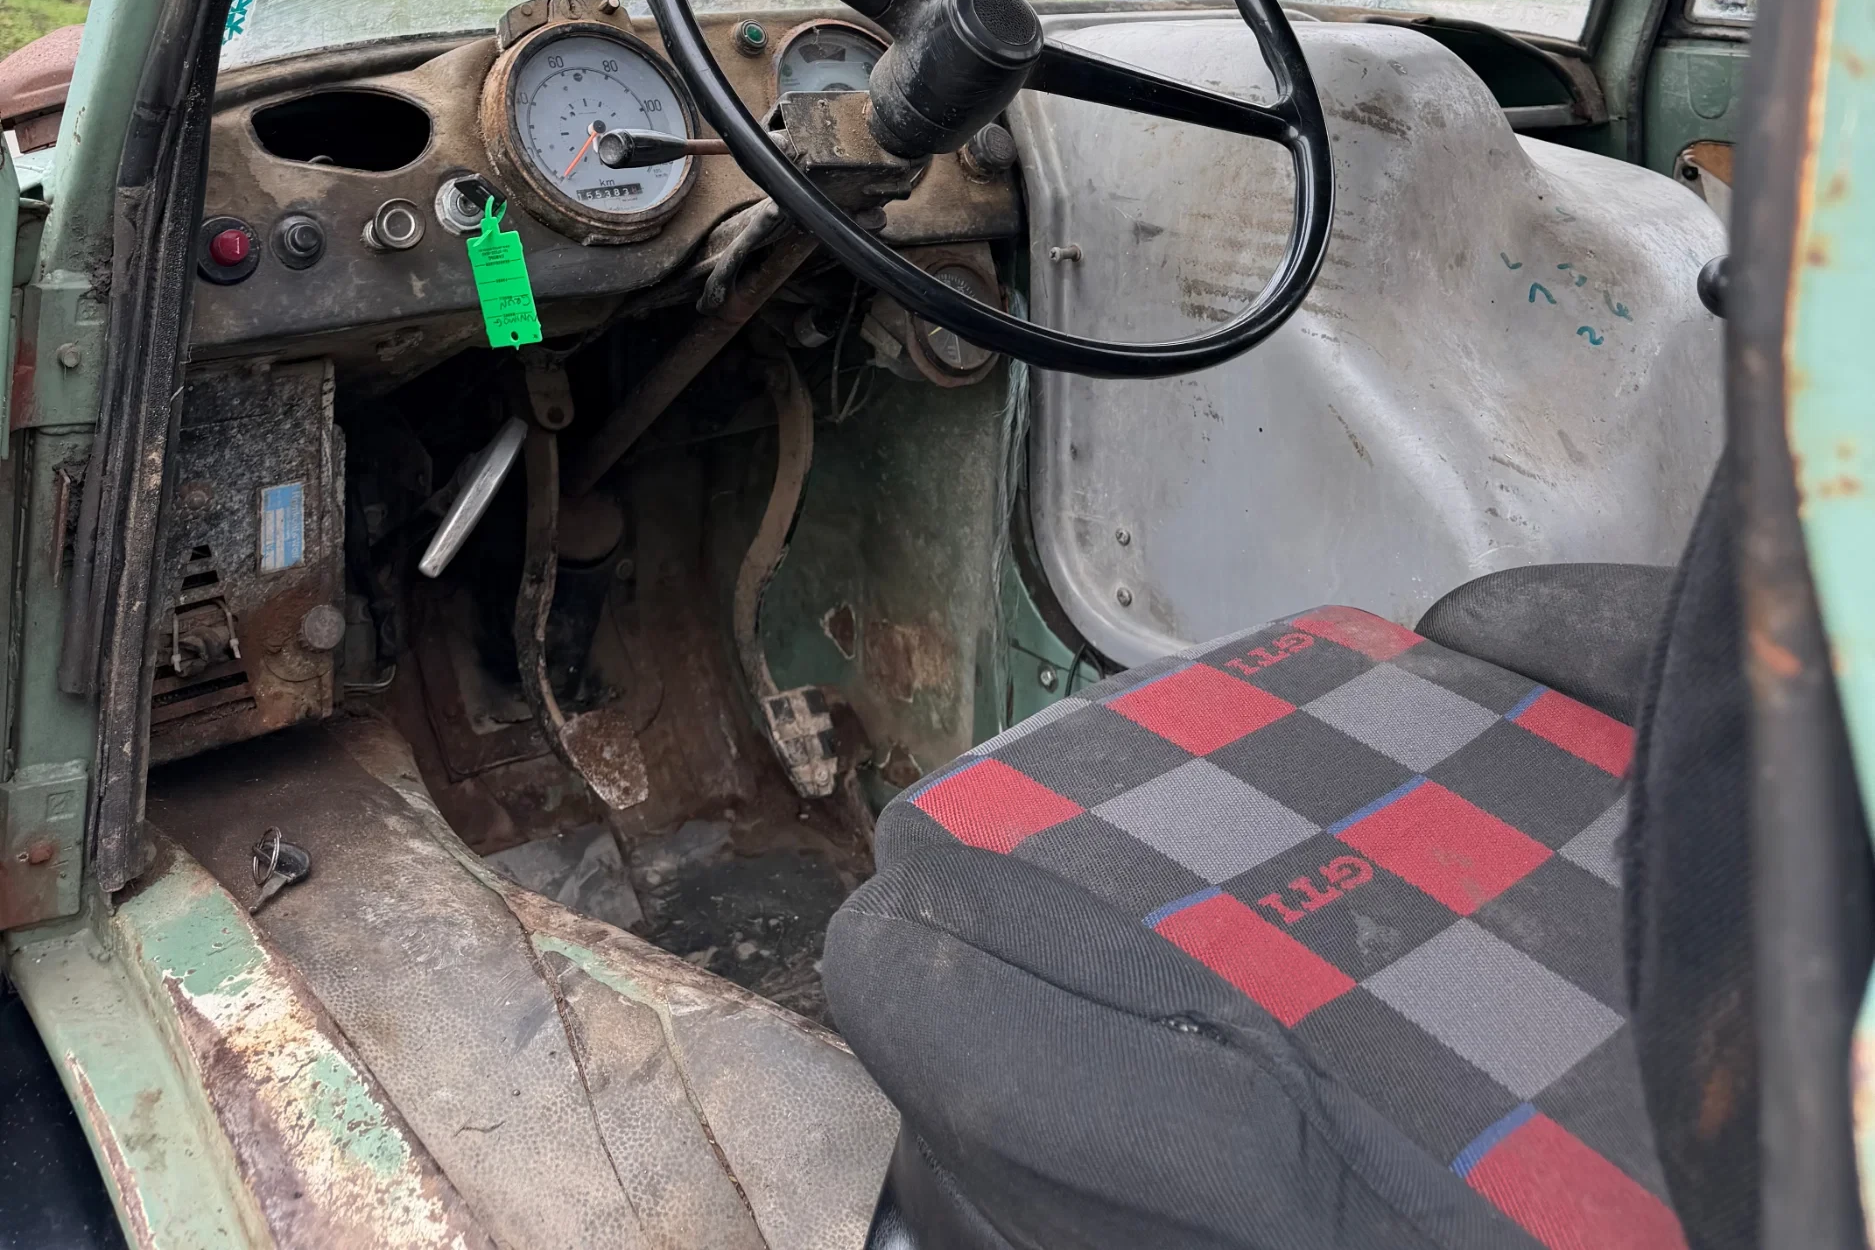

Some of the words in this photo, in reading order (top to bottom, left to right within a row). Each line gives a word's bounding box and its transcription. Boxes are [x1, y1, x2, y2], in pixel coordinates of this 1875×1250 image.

[547, 55, 564, 69] 60
[602, 59, 618, 73] 80
[643, 99, 662, 112] 100
[599, 178, 616, 187] km
[1223, 632, 1315, 676] GTI
[1257, 855, 1374, 925] GTI
